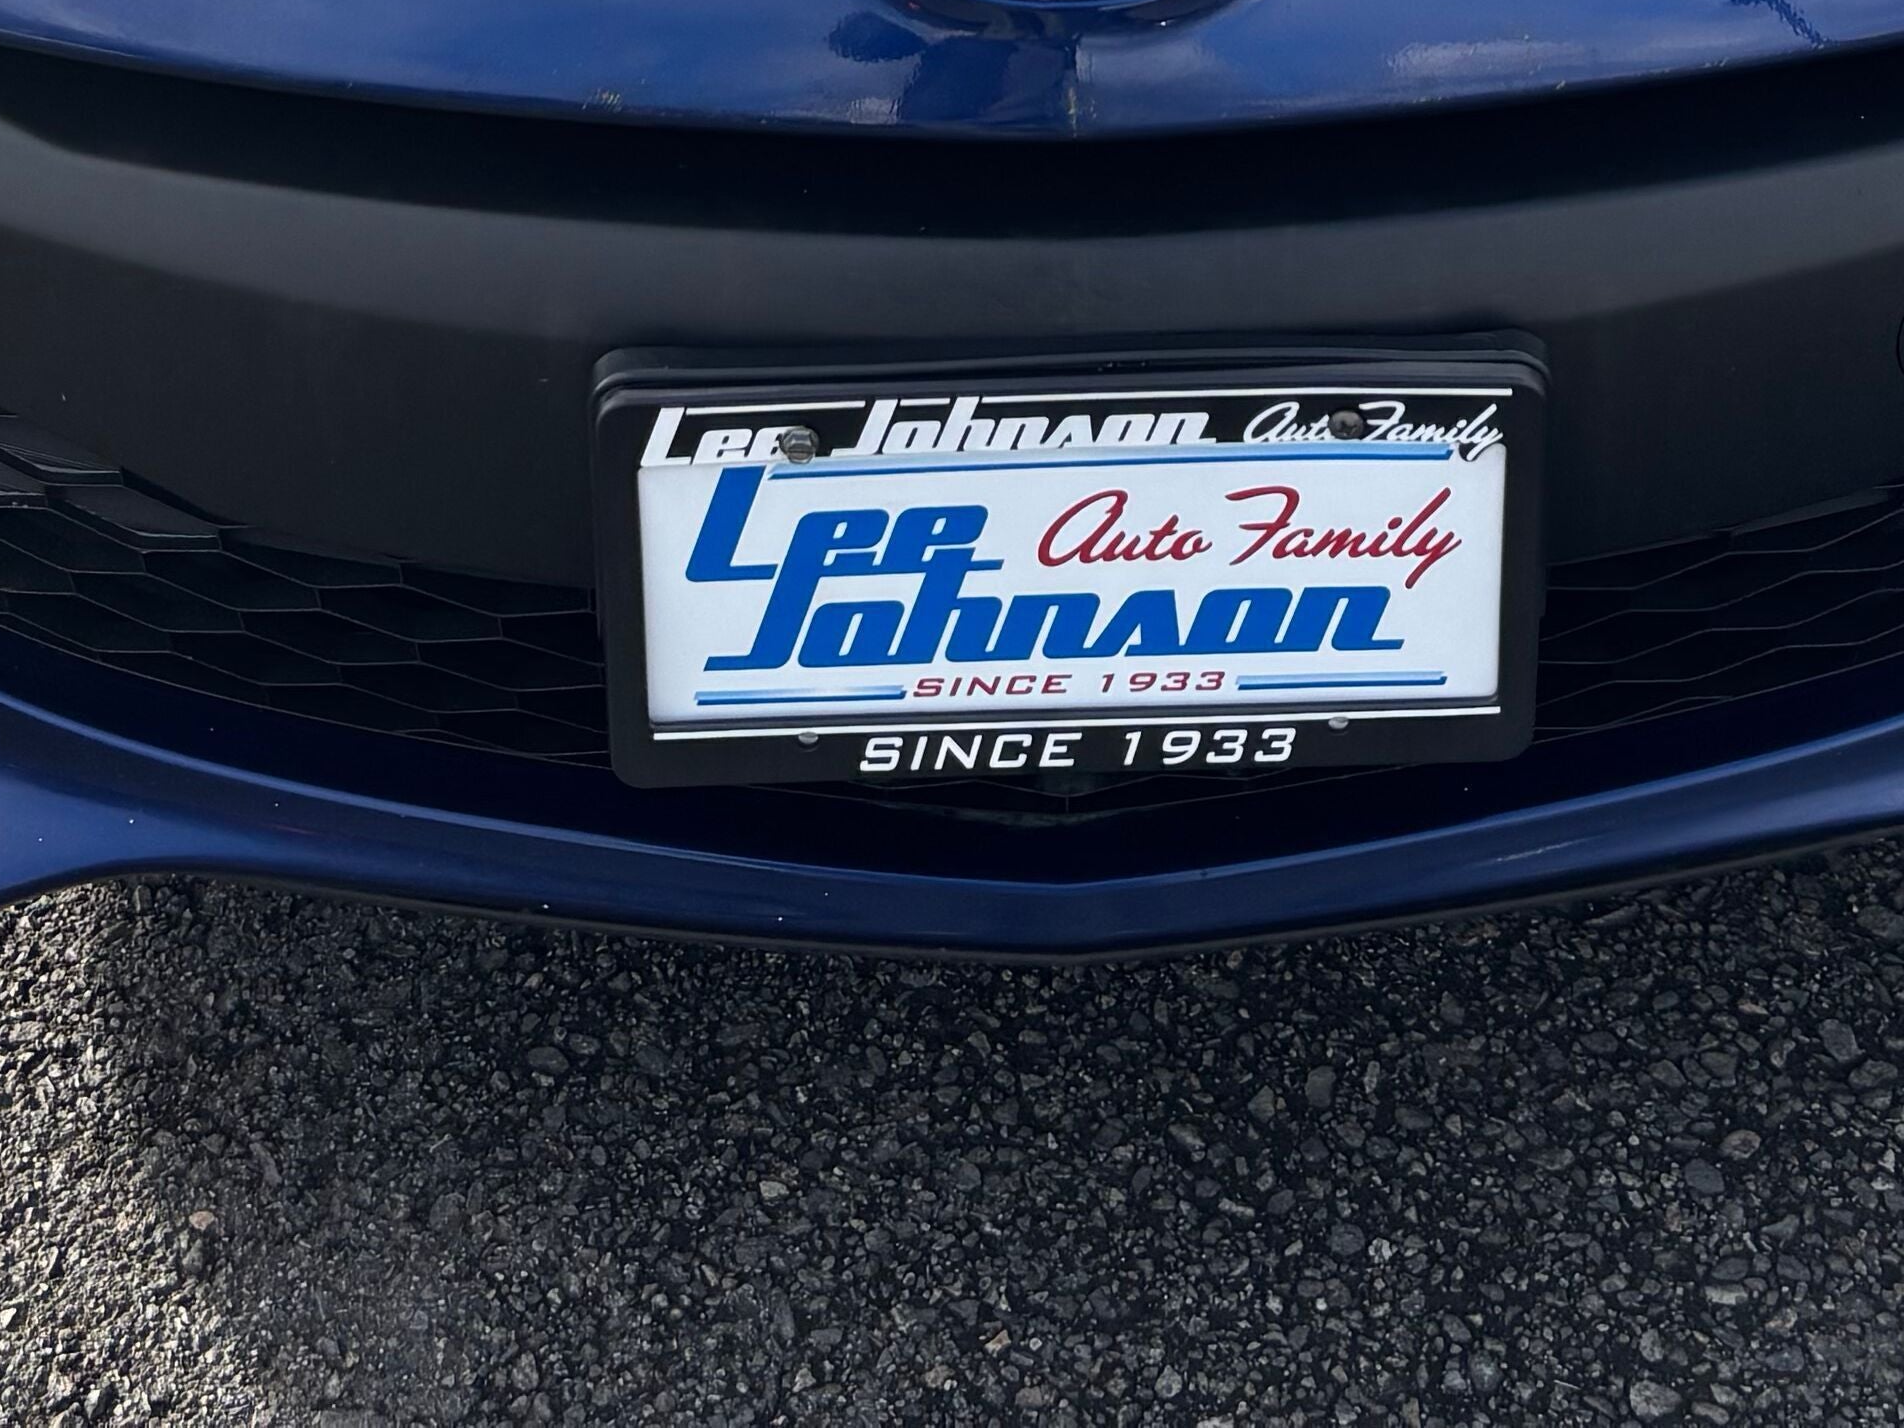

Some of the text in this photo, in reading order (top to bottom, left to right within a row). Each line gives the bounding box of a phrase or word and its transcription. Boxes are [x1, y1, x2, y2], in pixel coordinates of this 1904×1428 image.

[831, 396, 1216, 456] Johnson
[1243, 401, 1361, 443] Aut
[1358, 400, 1503, 462] Family
[685, 465, 1463, 590] Lee Auto Family
[703, 546, 1405, 672] Johnson
[912, 670, 1226, 698] SINCE 1933
[859, 726, 1297, 772] SINCE 1933
